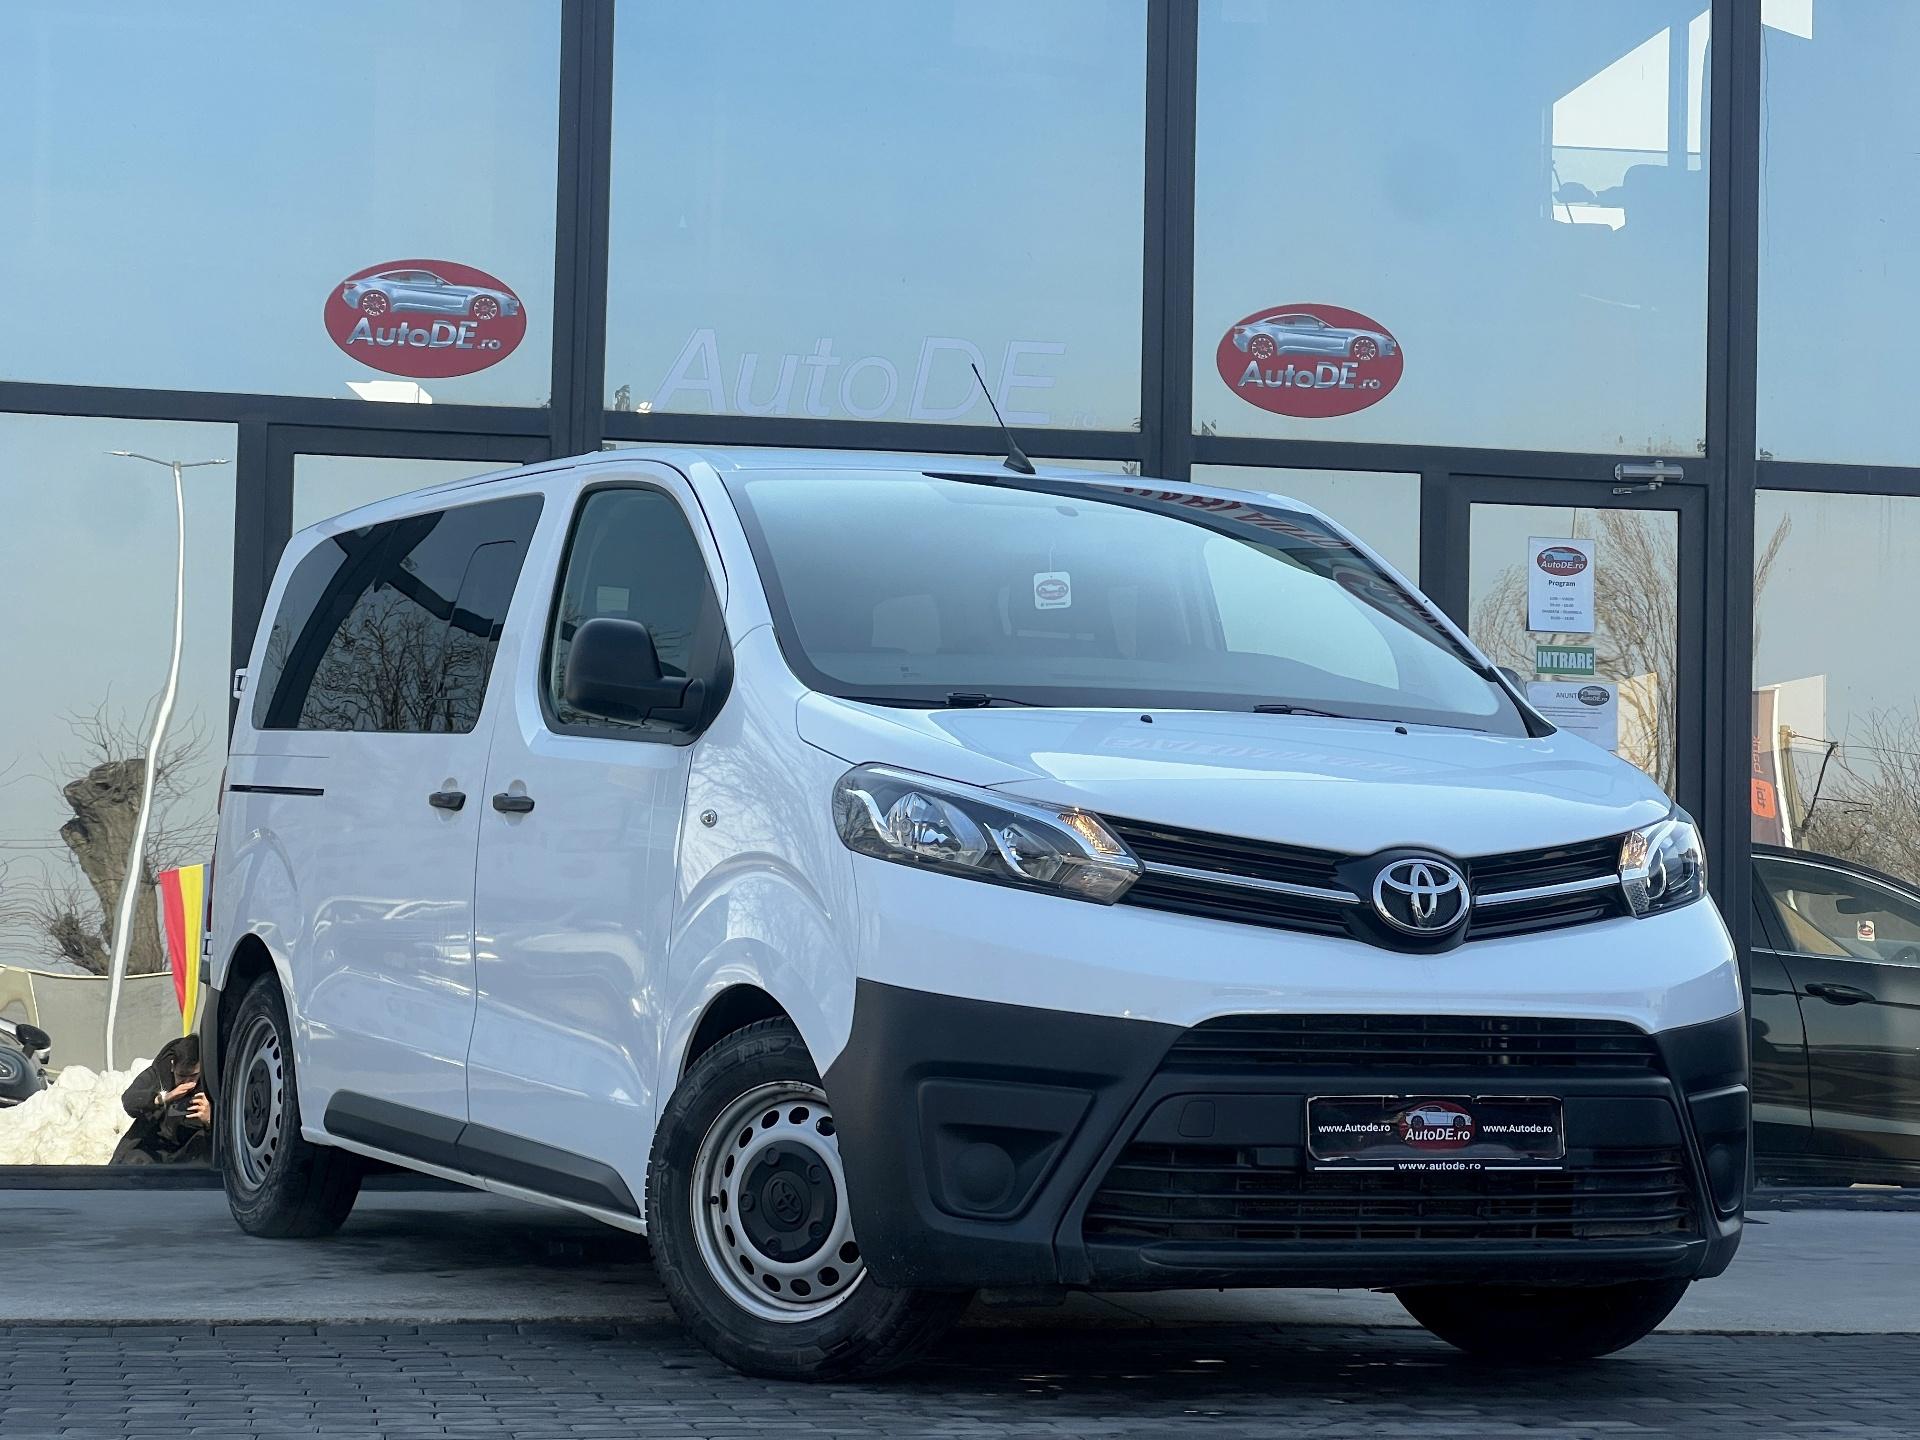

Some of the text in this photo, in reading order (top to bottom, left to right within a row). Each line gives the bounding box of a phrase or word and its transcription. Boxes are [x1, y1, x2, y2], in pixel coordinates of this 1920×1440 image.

[1540, 561, 1585, 570] AutoDE.ro
[1548, 580, 1576, 588] Program
[1537, 651, 1593, 669] INTRARE
[1318, 1123, 1391, 1133] www.Autode.ro
[1483, 1123, 1553, 1134] www.Autode.ro
[1404, 1128, 1471, 1142] AutoDE.ro
[1398, 1162, 1481, 1171] www.autode.ro
